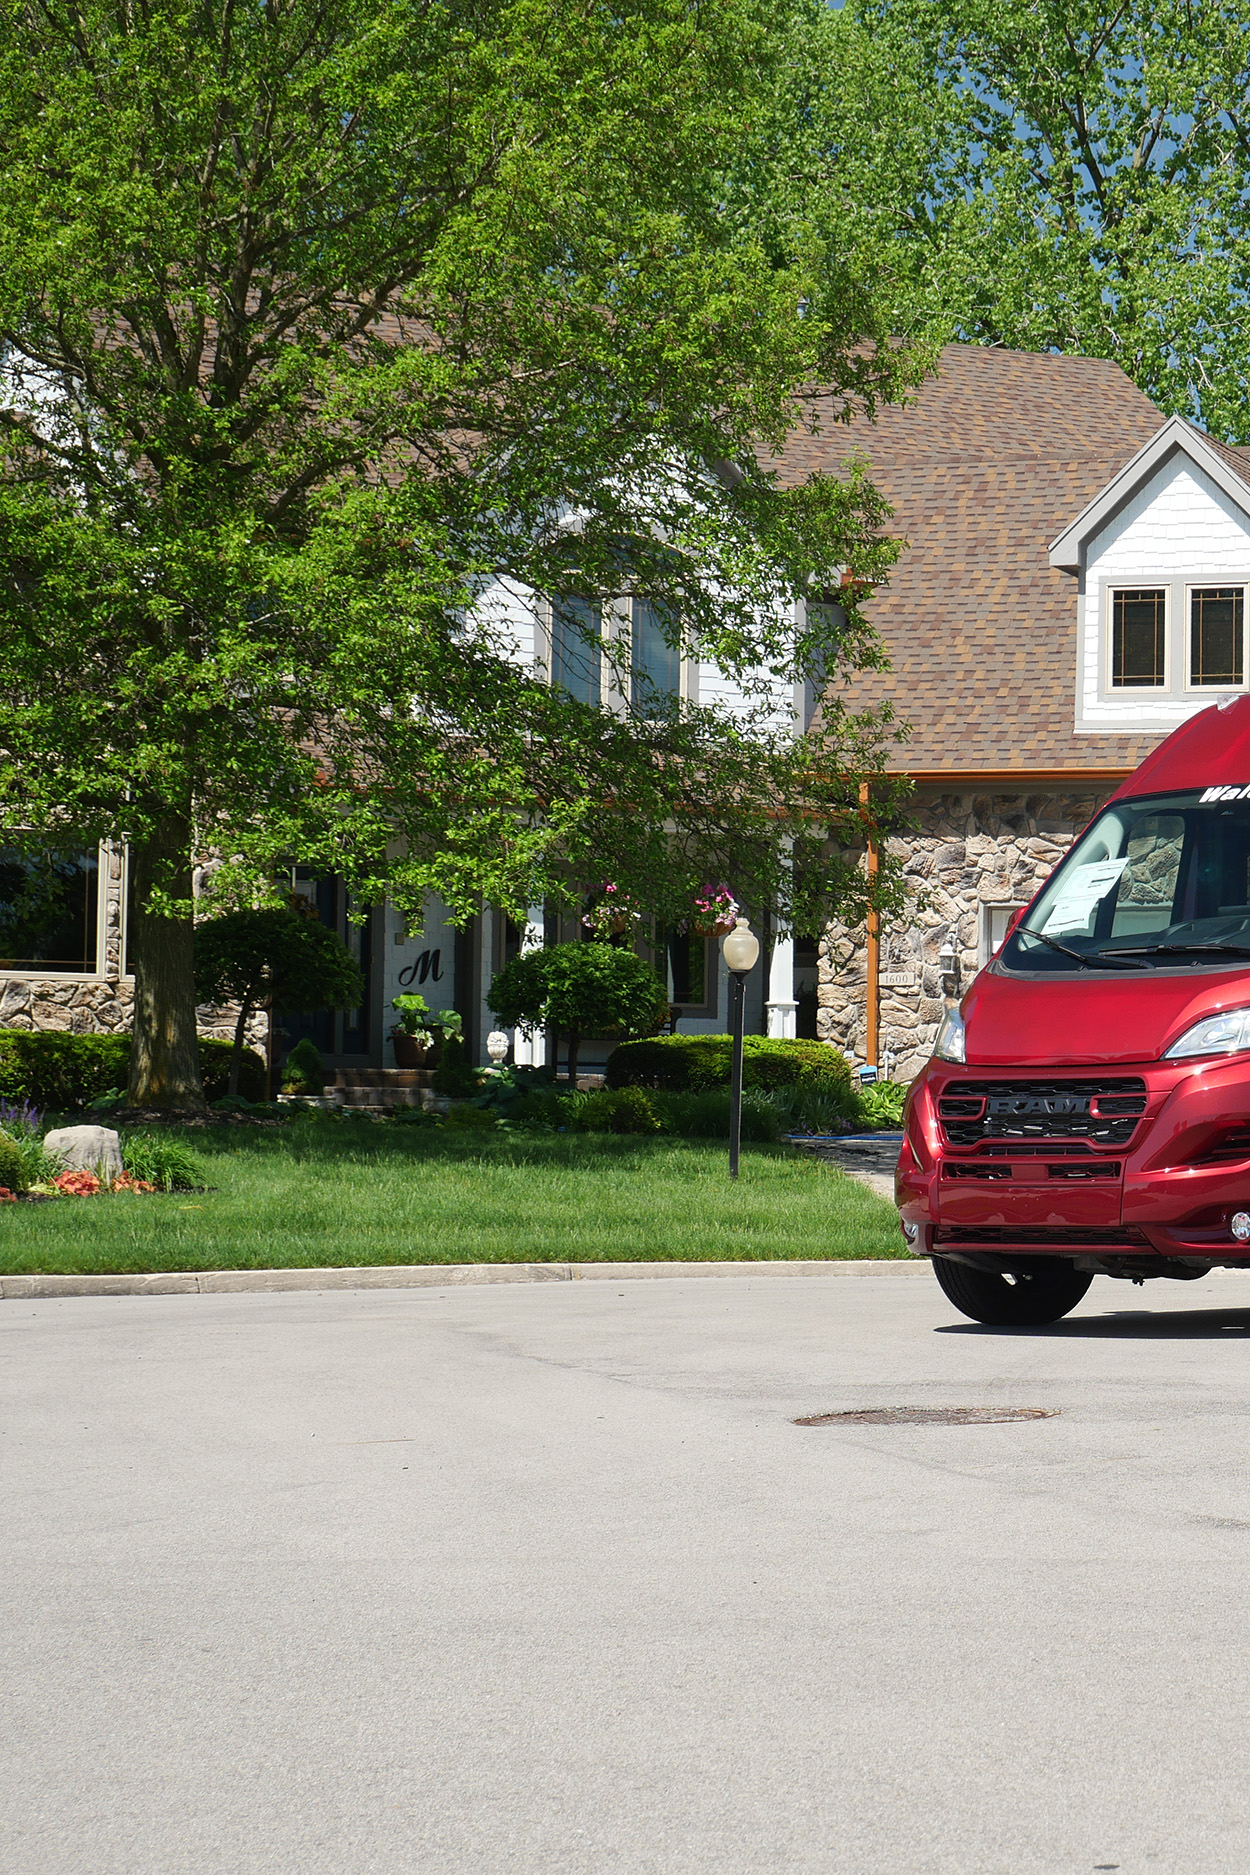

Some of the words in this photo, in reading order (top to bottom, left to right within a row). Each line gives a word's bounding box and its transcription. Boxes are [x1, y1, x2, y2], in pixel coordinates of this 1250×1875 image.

[398, 949, 444, 986] M
[885, 974, 909, 984] 1600
[987, 1097, 1090, 1114] RAM
